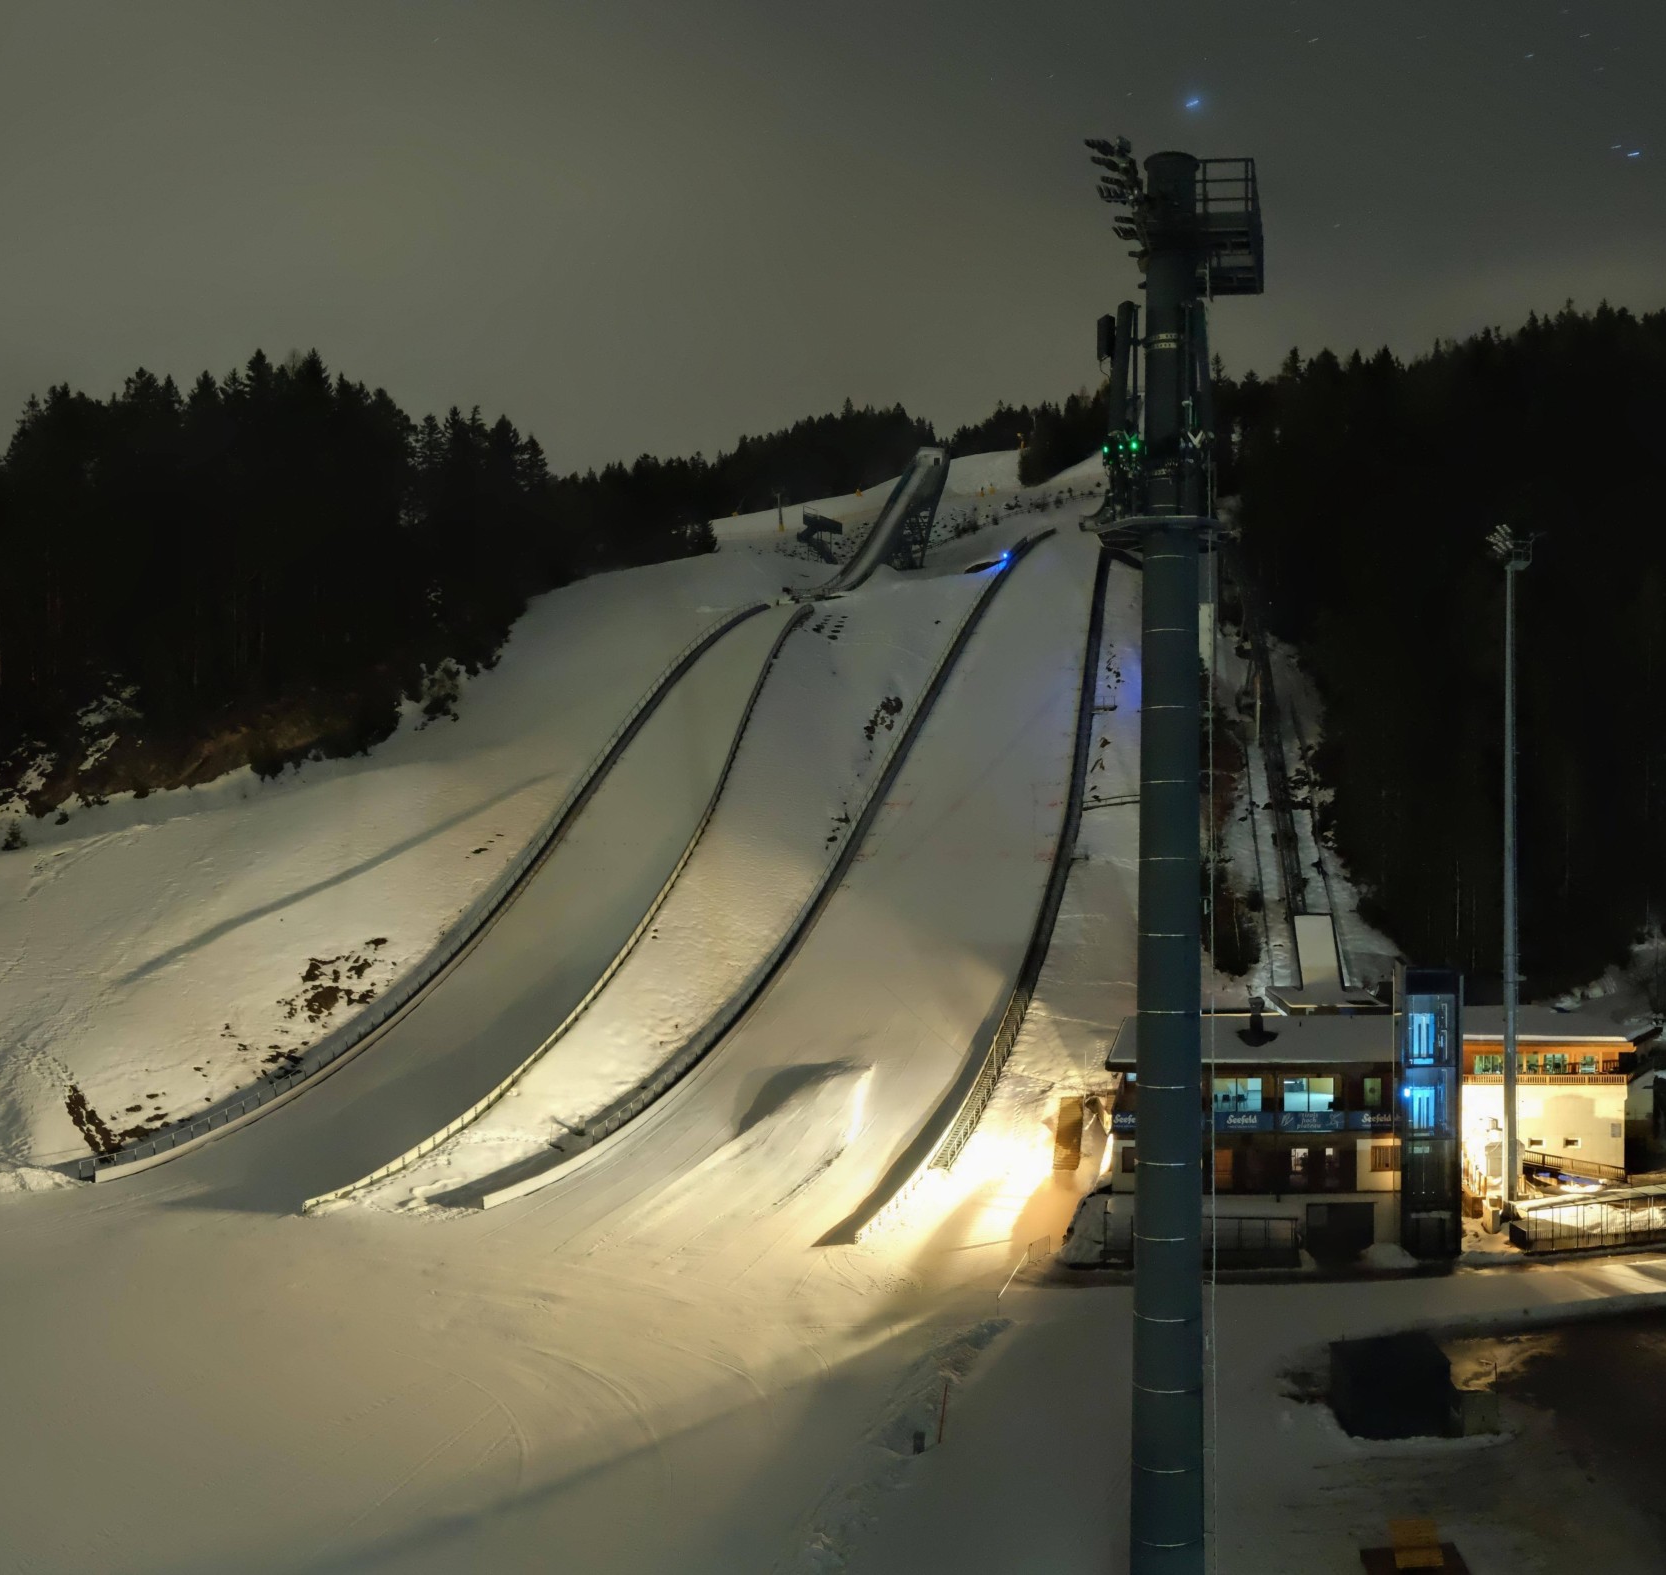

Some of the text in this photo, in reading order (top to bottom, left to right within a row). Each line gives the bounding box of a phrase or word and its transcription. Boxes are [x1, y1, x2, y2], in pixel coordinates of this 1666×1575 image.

[1113, 1114, 1136, 1124] Seefe
[1226, 1114, 1257, 1125] Seefeld
[1361, 1113, 1391, 1123] Seefeld
